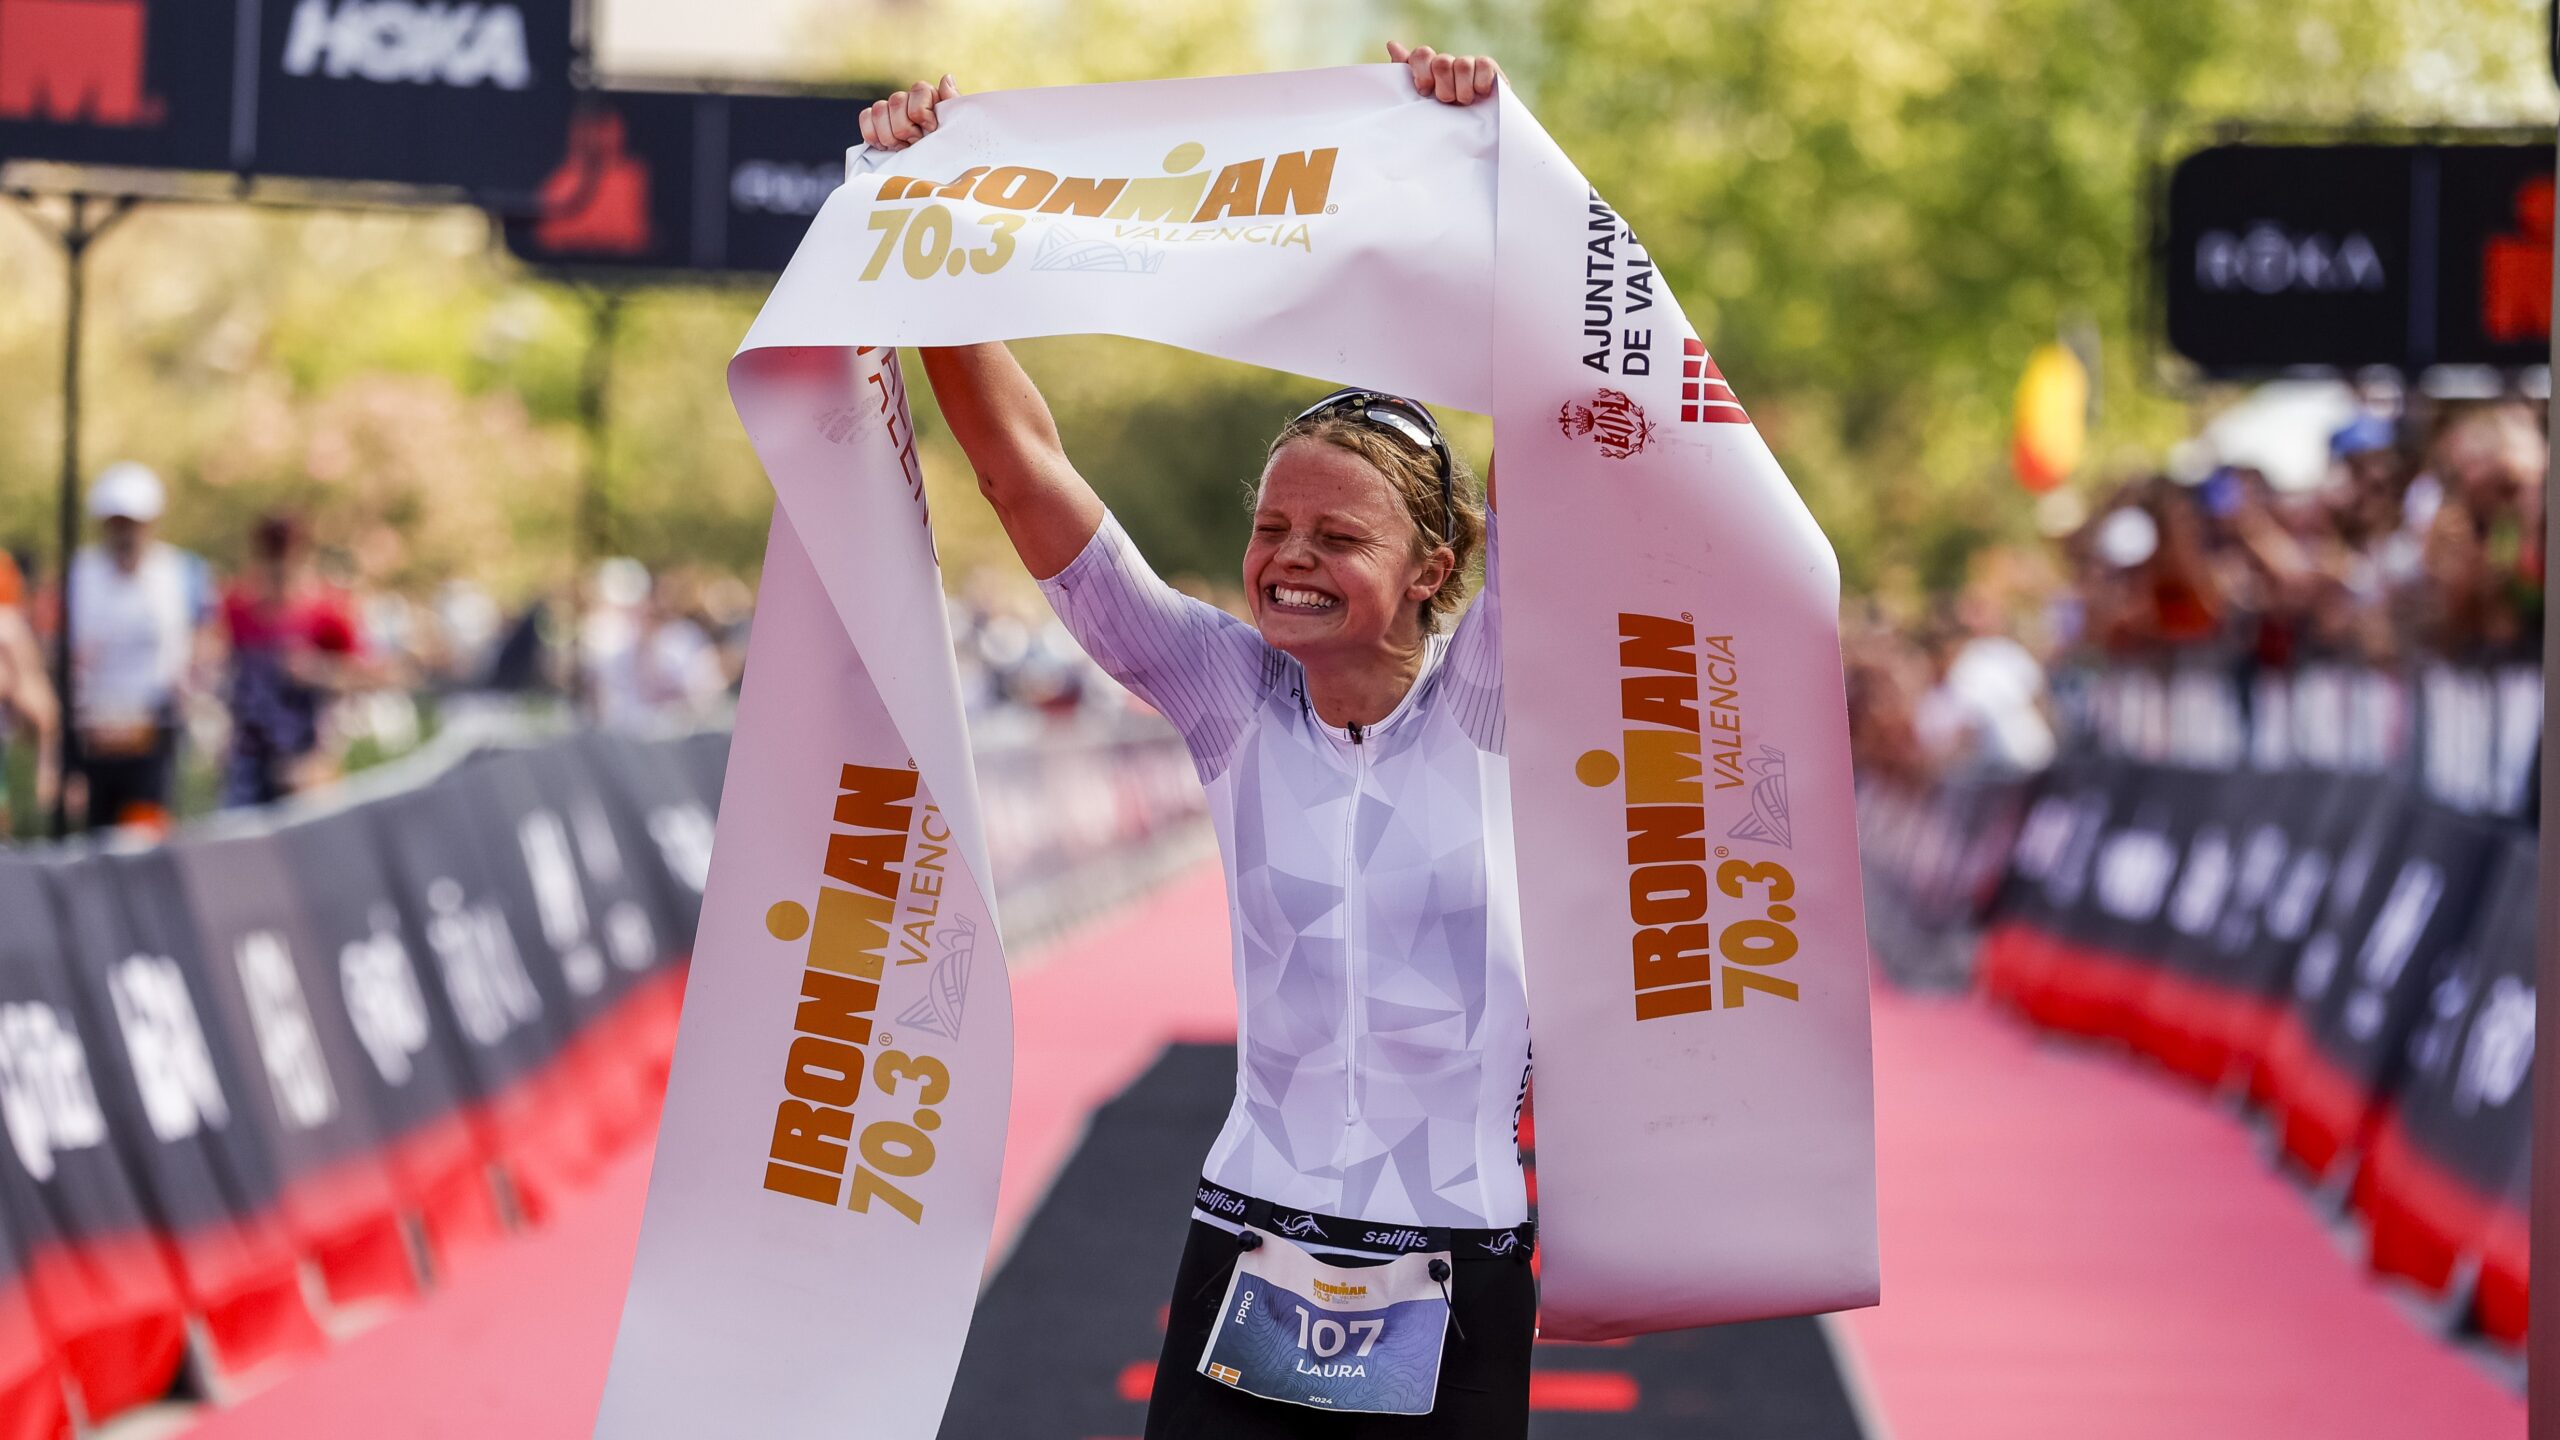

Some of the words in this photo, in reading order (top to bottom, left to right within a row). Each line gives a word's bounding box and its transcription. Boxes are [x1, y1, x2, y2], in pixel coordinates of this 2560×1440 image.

[282, 0, 530, 89] HOKA
[858, 204, 1026, 281] 70.3
[1114, 223, 1313, 253] VALENCIA
[1622, 329, 1651, 376] DE
[1706, 634, 1745, 791] VALENCIA
[1575, 612, 1712, 1021] IRONMAN
[896, 804, 951, 967] VALENCI
[1716, 859, 1799, 1010] 70.3
[763, 762, 919, 1206] IRONMAN
[848, 1049, 951, 1226] 70.3
[1196, 1187, 1246, 1216] sailfish
[1362, 1229, 1428, 1251] sailfis
[1235, 1290, 1254, 1325] FPRO
[1313, 1278, 1367, 1296] IRONMAN
[1295, 1304, 1385, 1358] 107
[1296, 1358, 1367, 1379] LAURA
[1308, 1395, 1333, 1405] 2024
